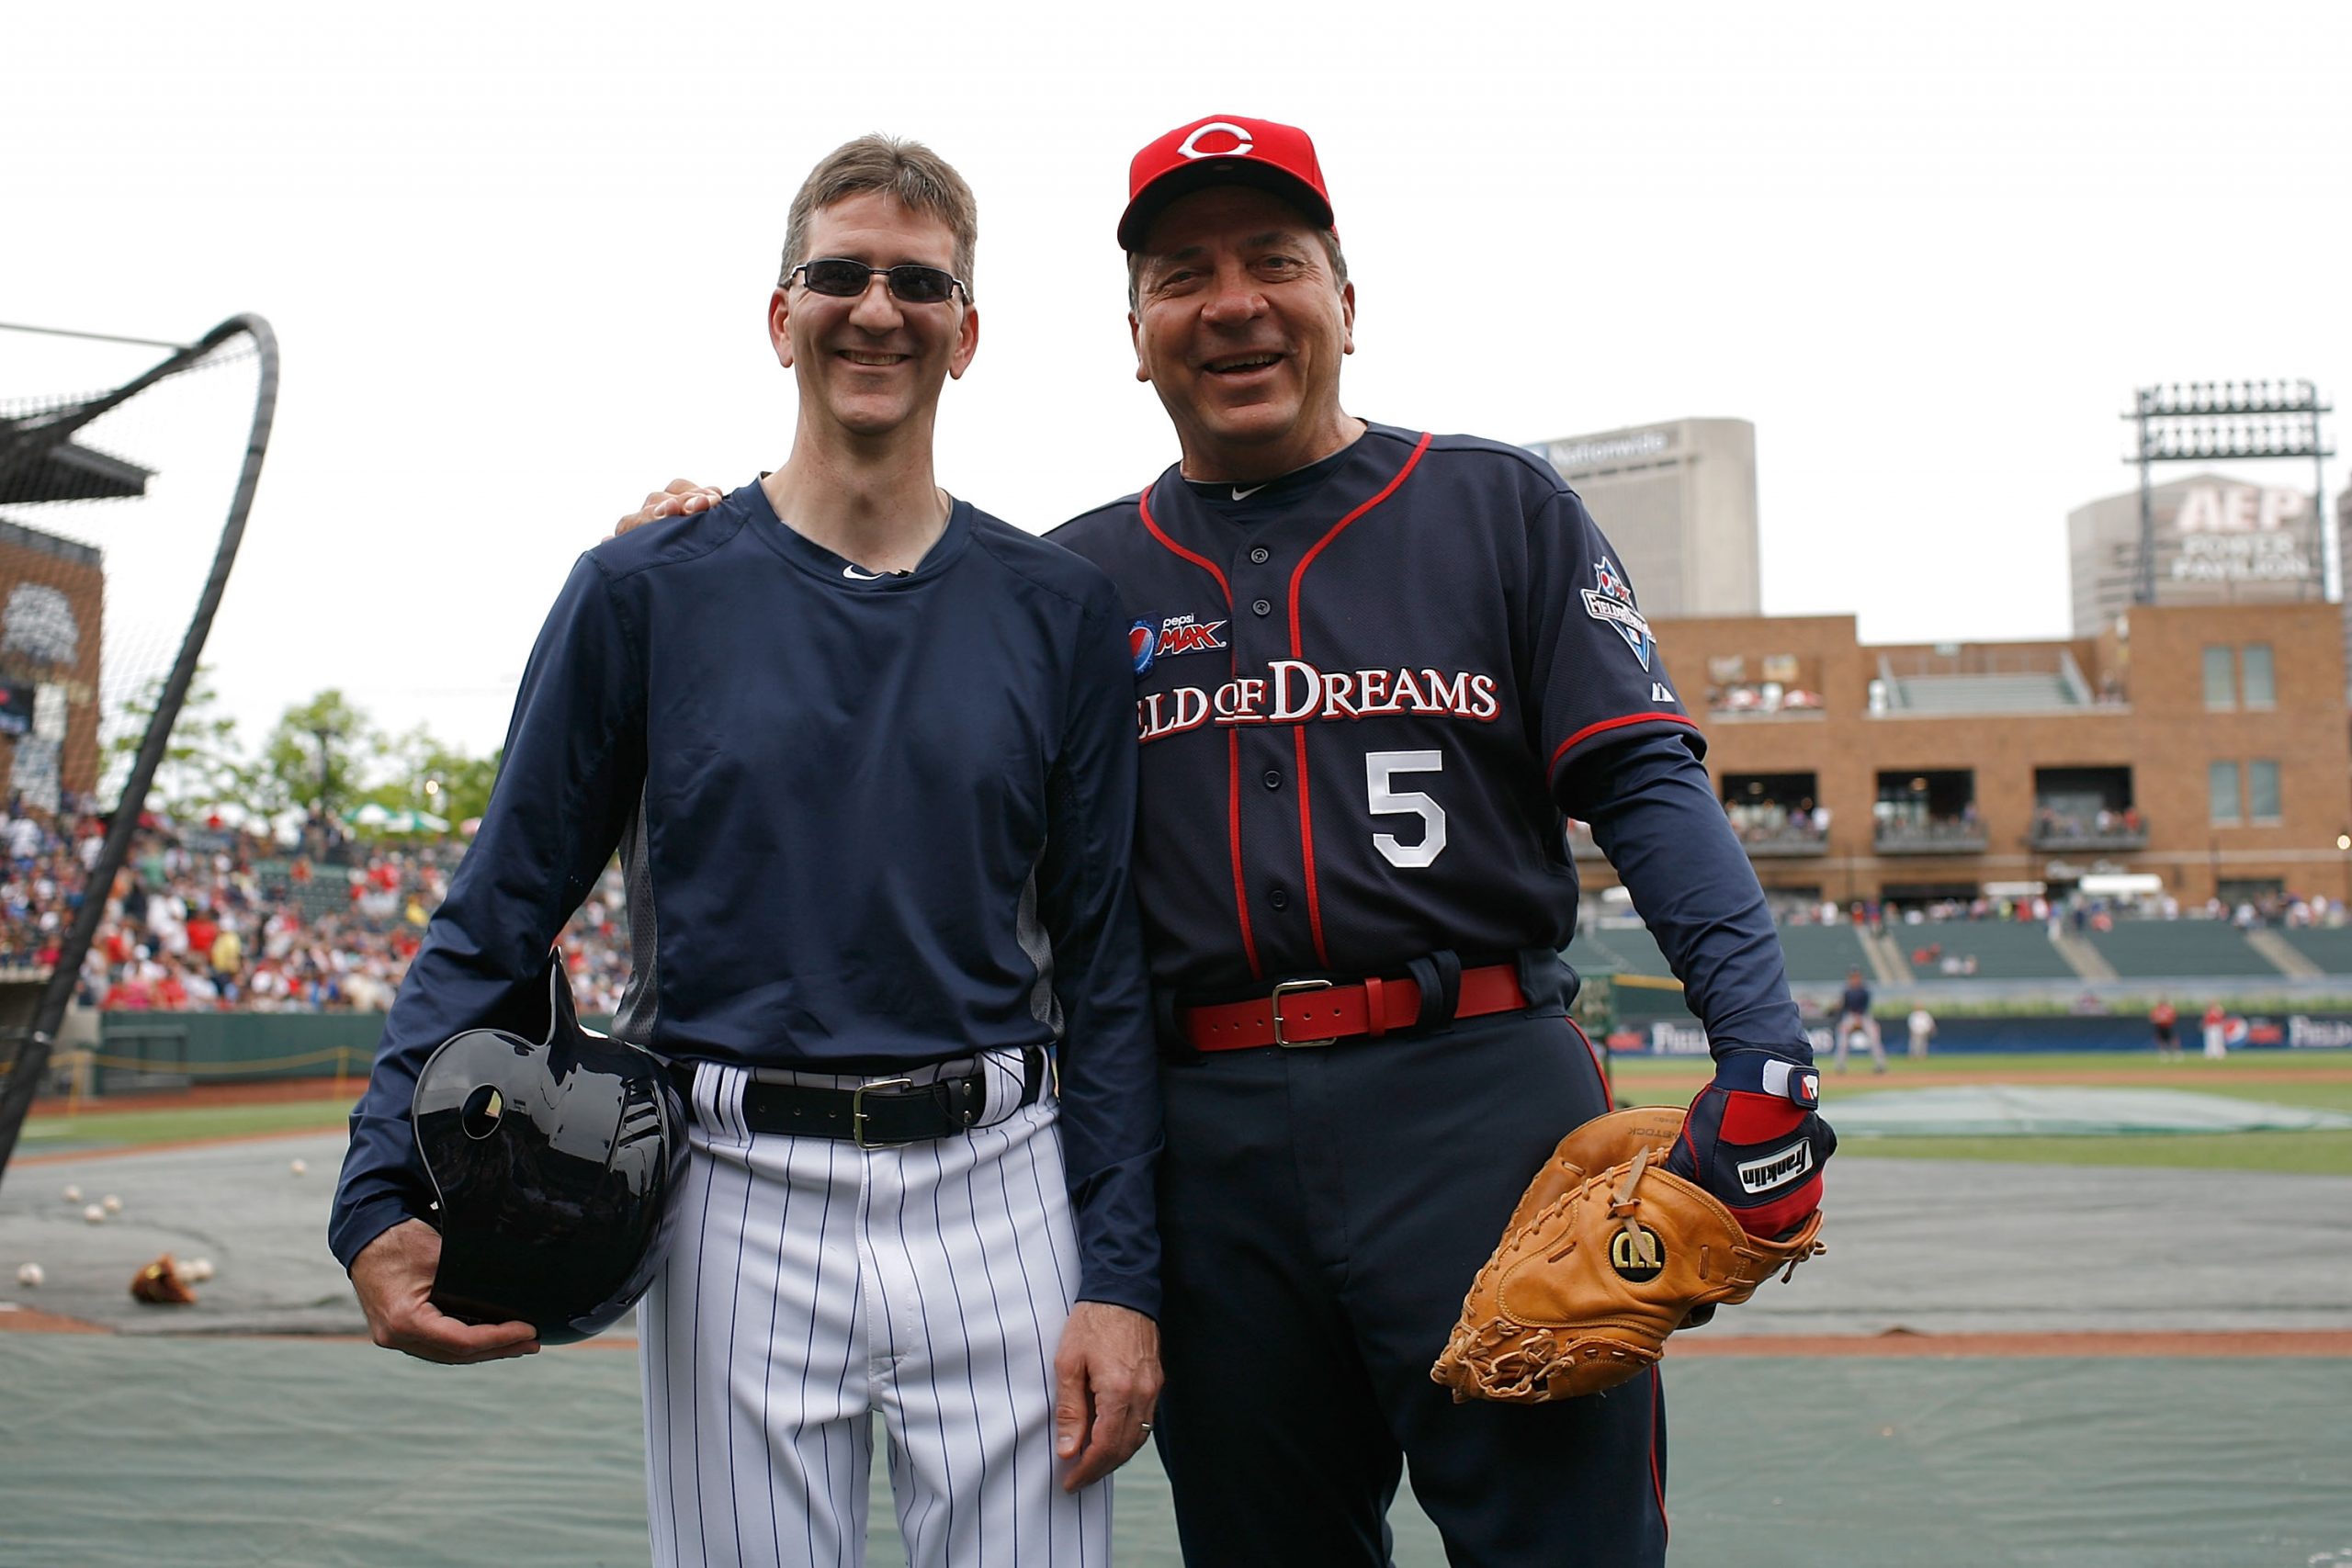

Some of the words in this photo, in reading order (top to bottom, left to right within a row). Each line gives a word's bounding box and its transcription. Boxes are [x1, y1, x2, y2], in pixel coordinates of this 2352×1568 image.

[1177, 121, 1254, 160] C
[2177, 486, 2306, 533] AEP
[1155, 620, 1227, 655] MAX
[1162, 613, 1194, 629] pepsi
[1214, 676, 1267, 723] OF
[1268, 660, 1500, 723] DREAMS
[1365, 750, 1447, 868] 5
[1742, 1140, 1808, 1187] Franklin
